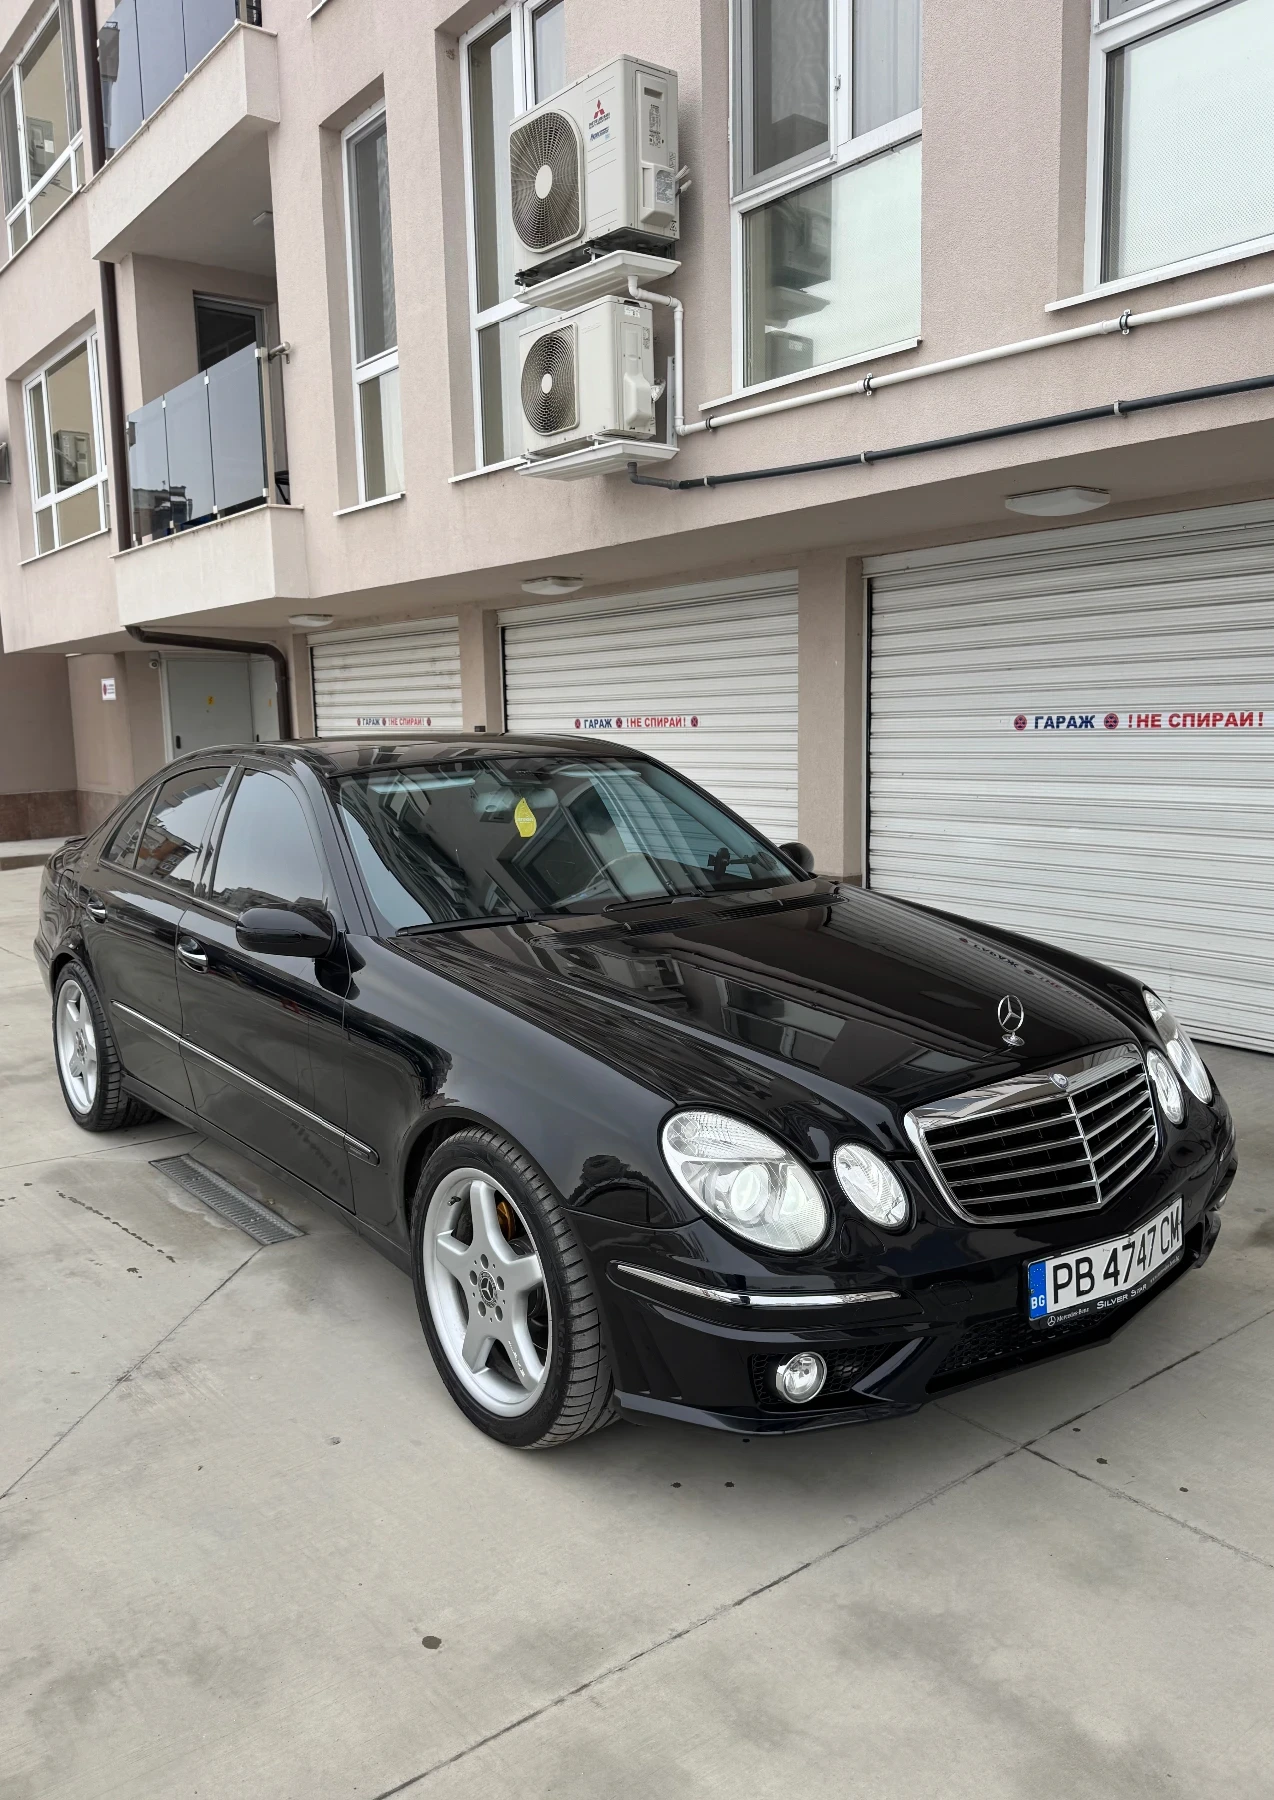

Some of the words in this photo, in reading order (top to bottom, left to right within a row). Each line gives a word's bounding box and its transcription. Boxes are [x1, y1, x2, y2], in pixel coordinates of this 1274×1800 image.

[362, 718, 380, 726] ГАРАЖ
[584, 718, 612, 728] ГАРАЖ
[1034, 714, 1096, 729] ГАРАЖ
[1052, 1256, 1096, 1305] PB
[1103, 1224, 1157, 1287] 4747
[1160, 1205, 1180, 1255] CM
[1030, 1294, 1046, 1310] BG
[1096, 1293, 1129, 1310] SILVER
[1130, 1283, 1147, 1297] STAR
